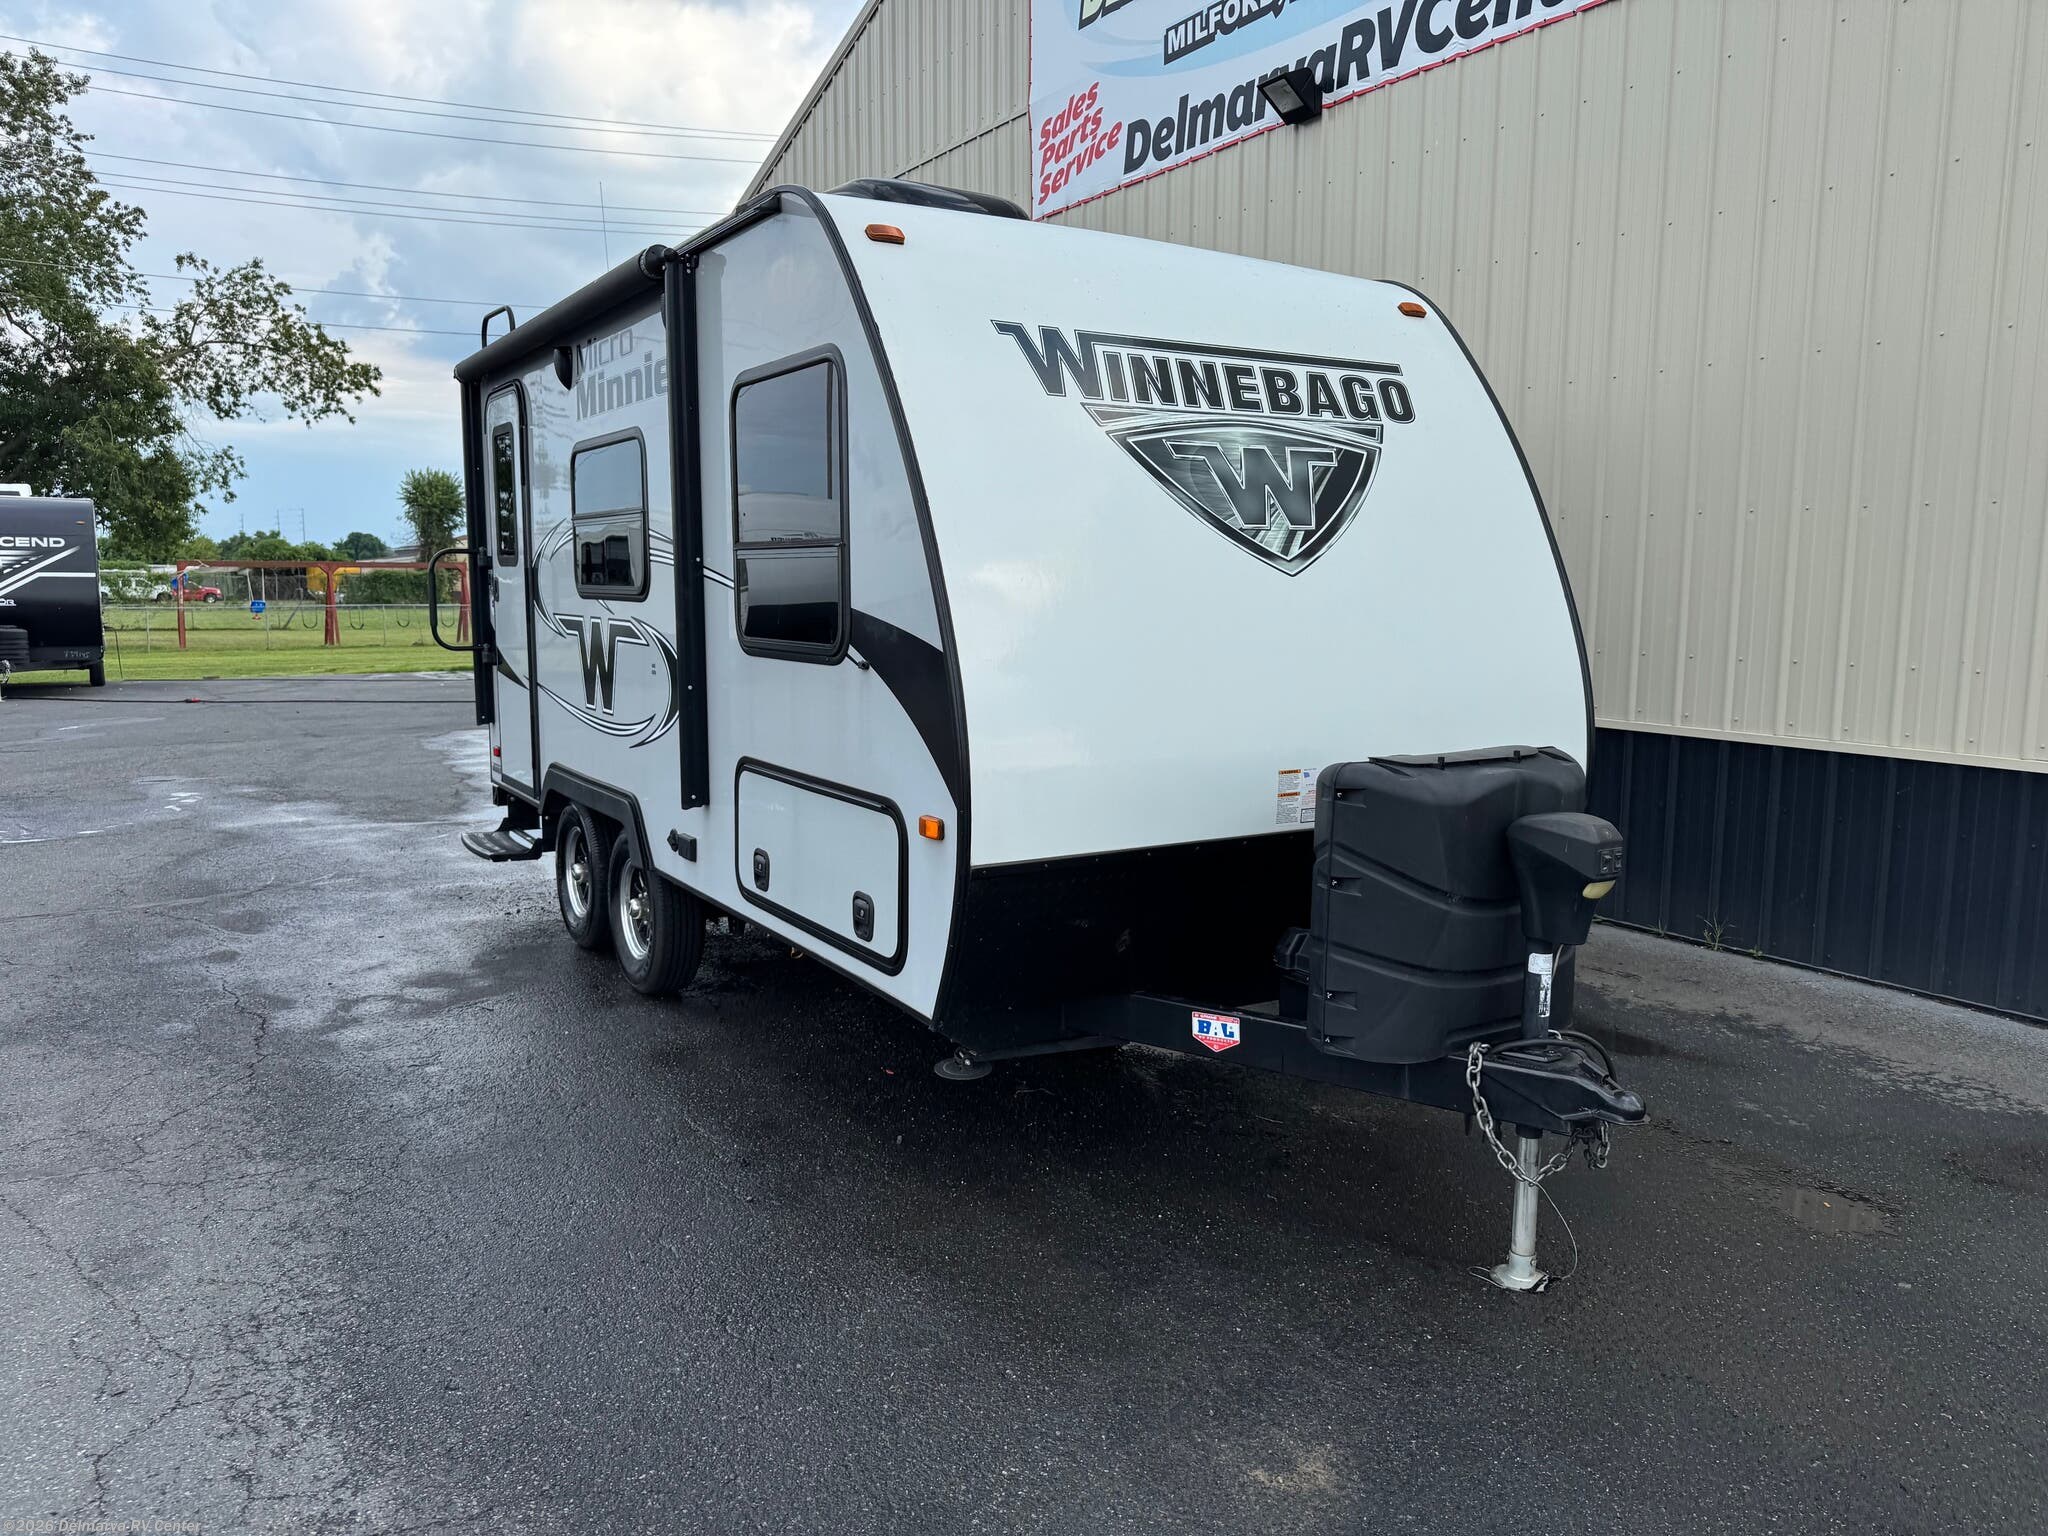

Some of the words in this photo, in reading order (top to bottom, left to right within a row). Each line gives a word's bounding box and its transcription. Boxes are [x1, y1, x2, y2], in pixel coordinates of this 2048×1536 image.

[1123, 0, 1563, 174] DelmaraRVCe
[576, 328, 633, 377] Micro
[576, 350, 667, 421] Minnie
[990, 319, 1416, 425] WINNEBAGO
[1163, 438, 1338, 530] W
[553, 613, 649, 715] W
